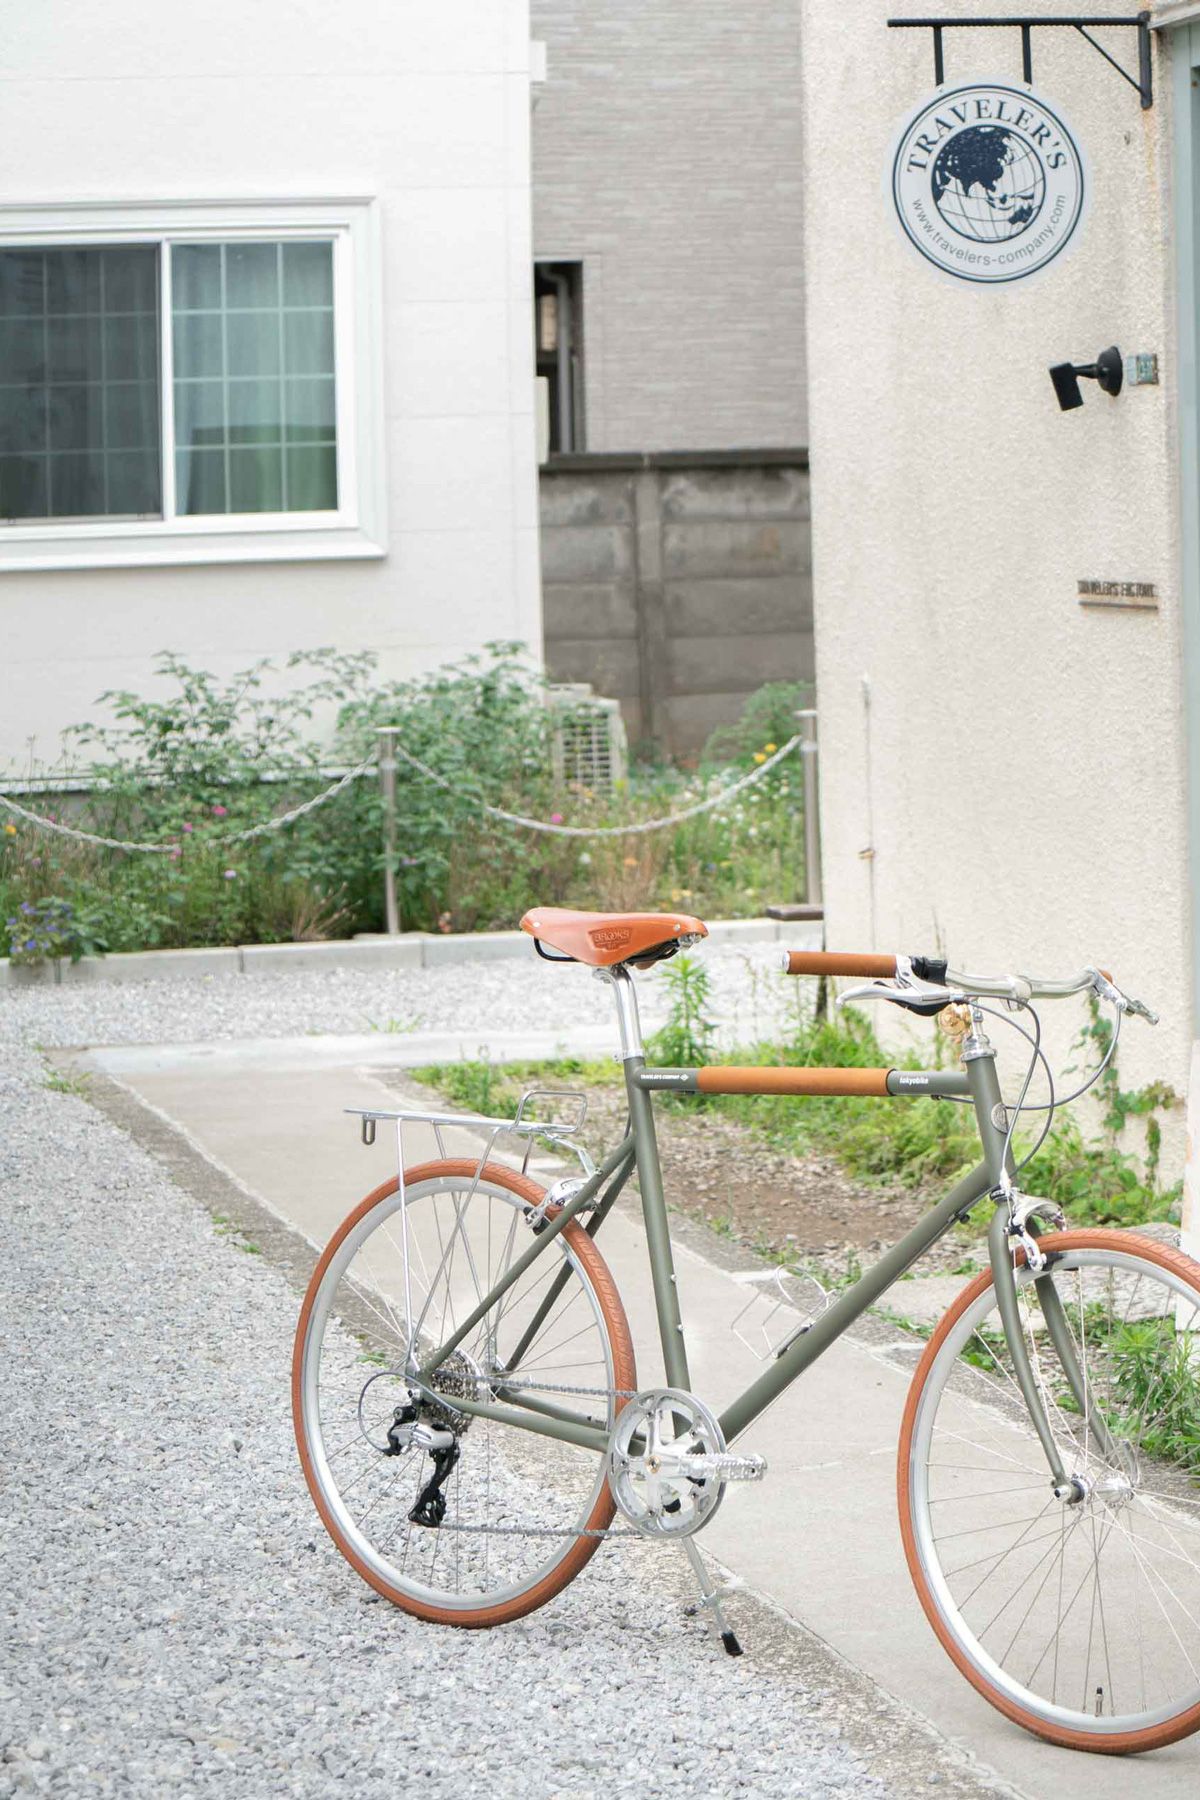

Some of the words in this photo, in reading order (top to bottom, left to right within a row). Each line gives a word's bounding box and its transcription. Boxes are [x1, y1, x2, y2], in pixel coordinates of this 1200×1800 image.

[907, 98, 1067, 174] TRAVELER'S
[912, 194, 1066, 266] www.travelers-company.com
[594, 930, 630, 942] BROOKS
[899, 1076, 929, 1086] tokyobike
